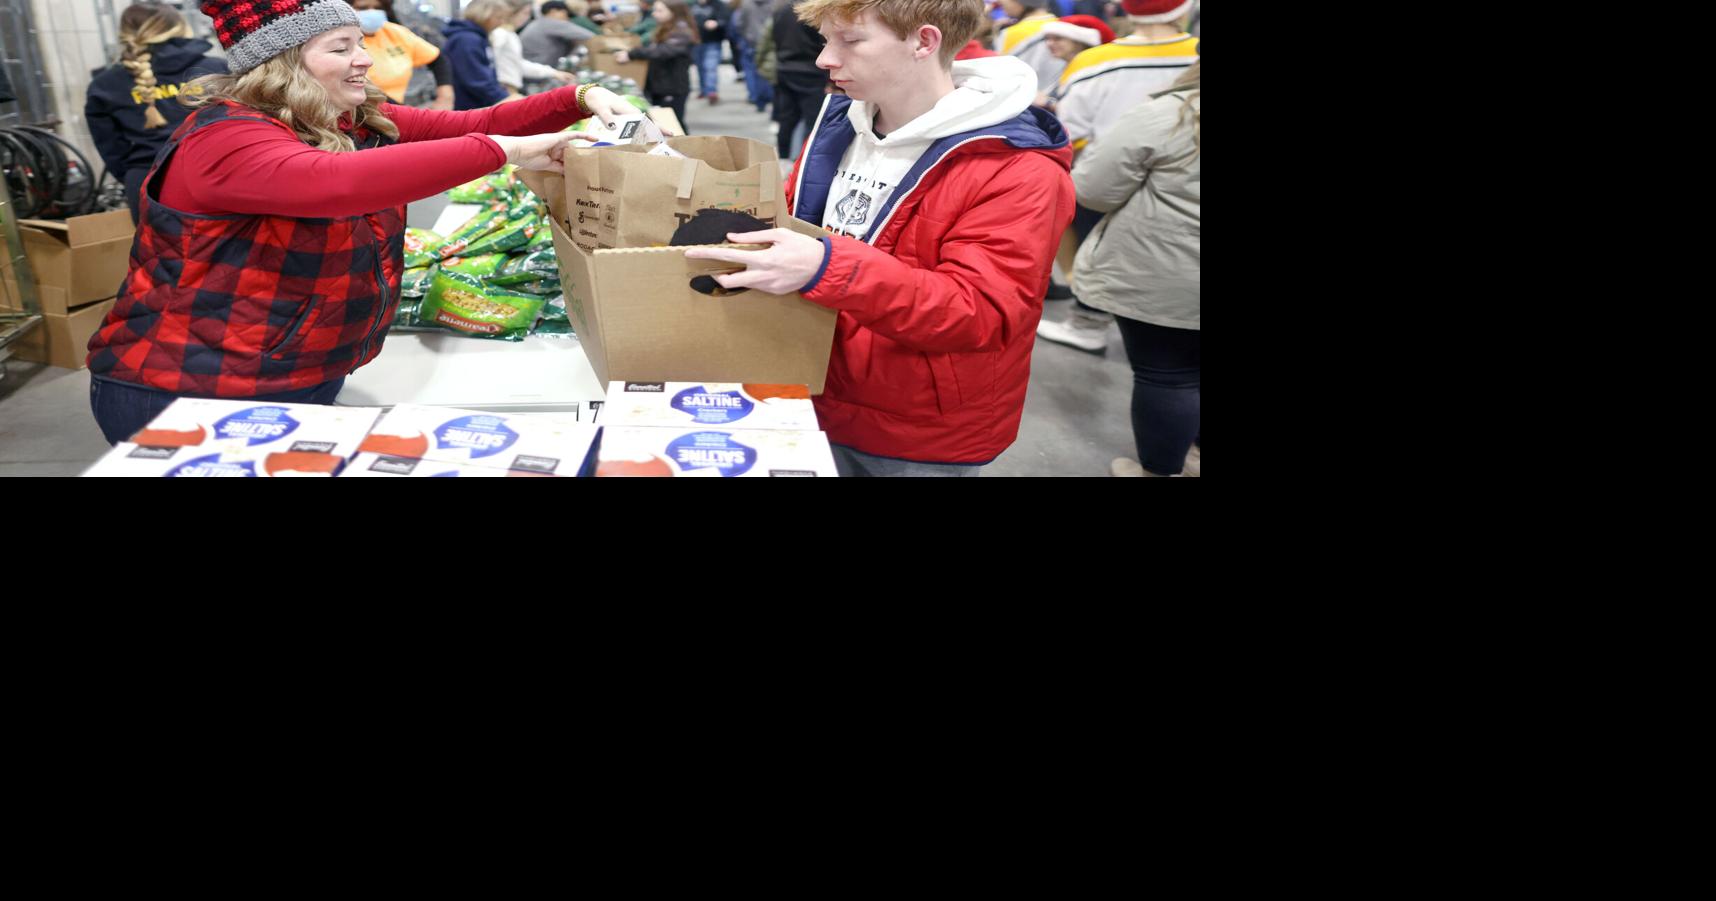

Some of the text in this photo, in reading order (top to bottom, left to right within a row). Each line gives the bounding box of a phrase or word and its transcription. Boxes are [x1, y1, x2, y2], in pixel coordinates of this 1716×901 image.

[682, 395, 742, 407] SALTINE
[221, 421, 287, 435] SALTINE
[440, 429, 507, 447] SALTINE
[678, 448, 745, 464] SALTINE
